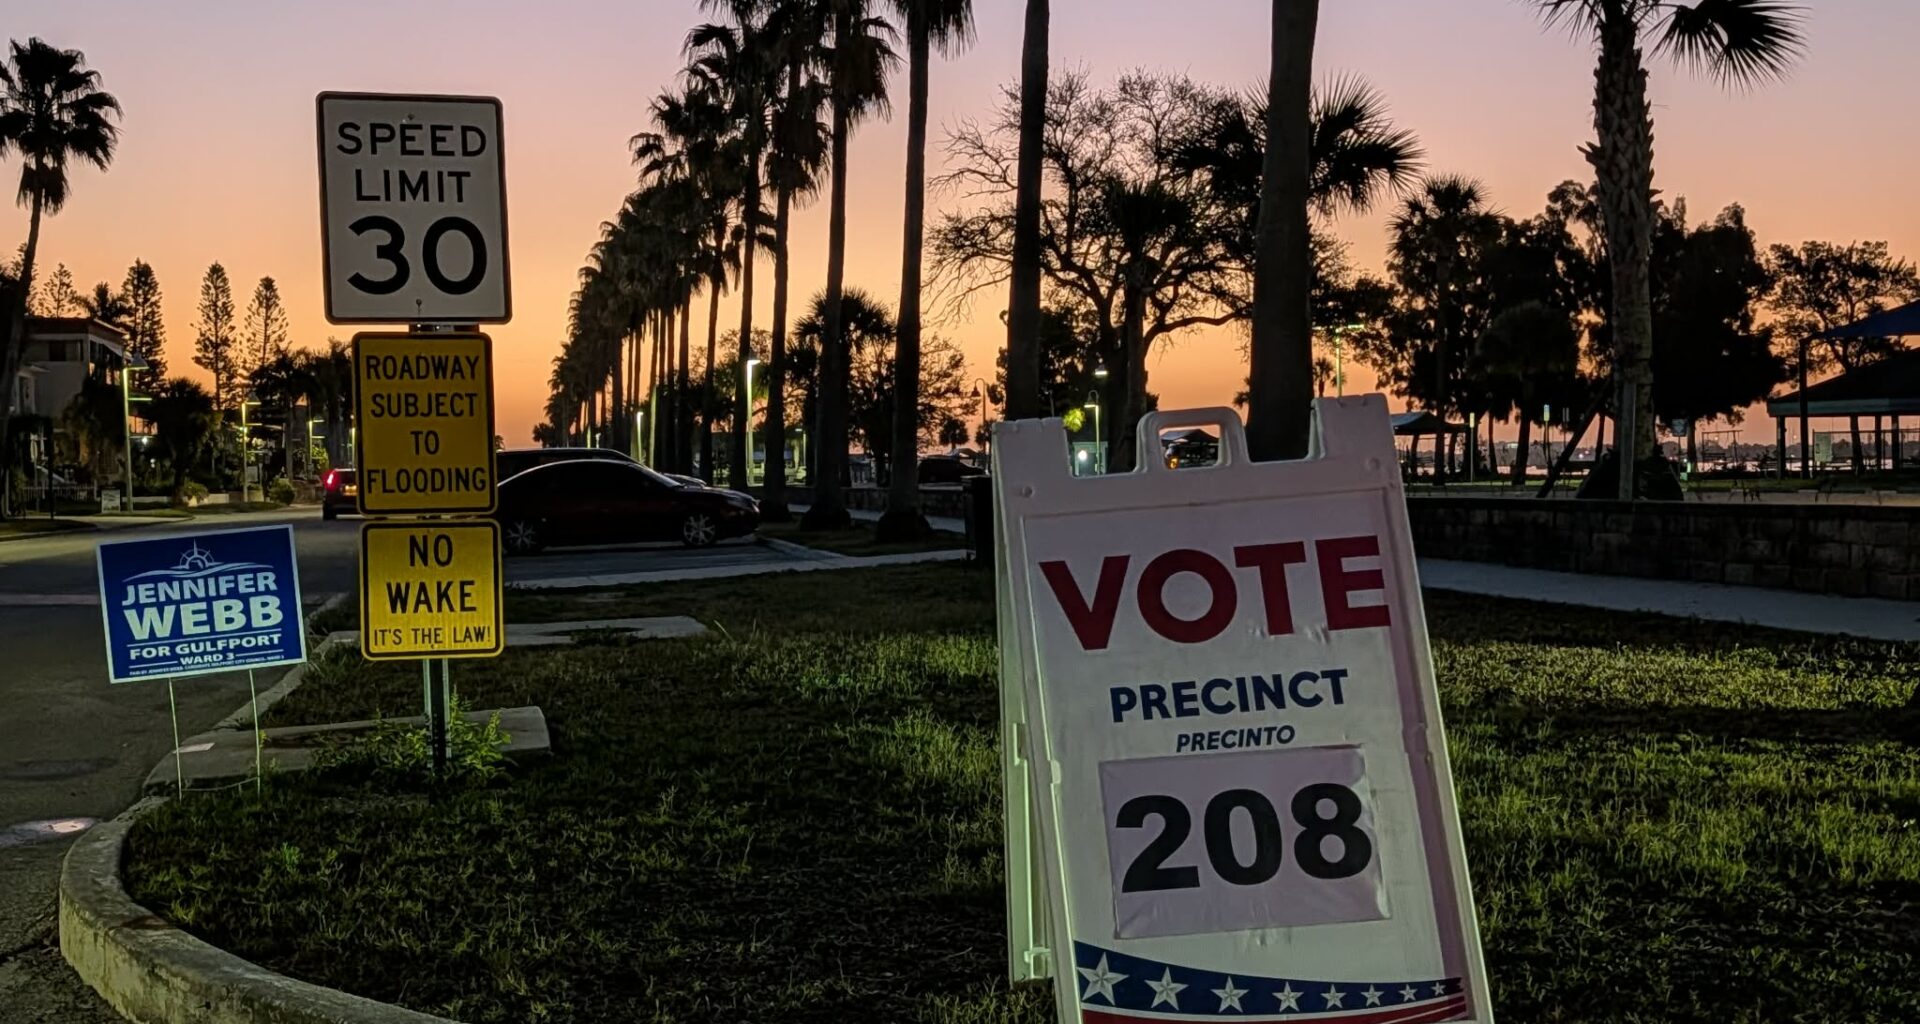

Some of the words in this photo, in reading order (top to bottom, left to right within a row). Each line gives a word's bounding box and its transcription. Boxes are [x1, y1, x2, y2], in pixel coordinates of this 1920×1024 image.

[337, 122, 486, 157] SPEED
[355, 169, 471, 203] LIMIT
[347, 215, 487, 295] 30
[366, 355, 479, 380] ROADWAY
[371, 393, 478, 418] SUBJECT
[410, 430, 440, 455] TO
[367, 467, 486, 494] FLOODING
[409, 534, 453, 567] NO
[122, 572, 278, 606] JENNIFER
[386, 580, 477, 614] WAKE
[1038, 535, 1391, 651] VOTE
[123, 595, 284, 641] WEBB
[130, 646, 171, 660] FOR
[175, 633, 282, 654] GULFPORT
[374, 628, 402, 646] IT'S
[412, 627, 443, 644] THE
[453, 626, 491, 643] LAW!
[180, 653, 223, 665] WARD
[226, 652, 235, 660] 3
[1109, 668, 1349, 723] PRECINCT
[1175, 724, 1296, 753] PRECINTO
[1115, 782, 1372, 893] 208
